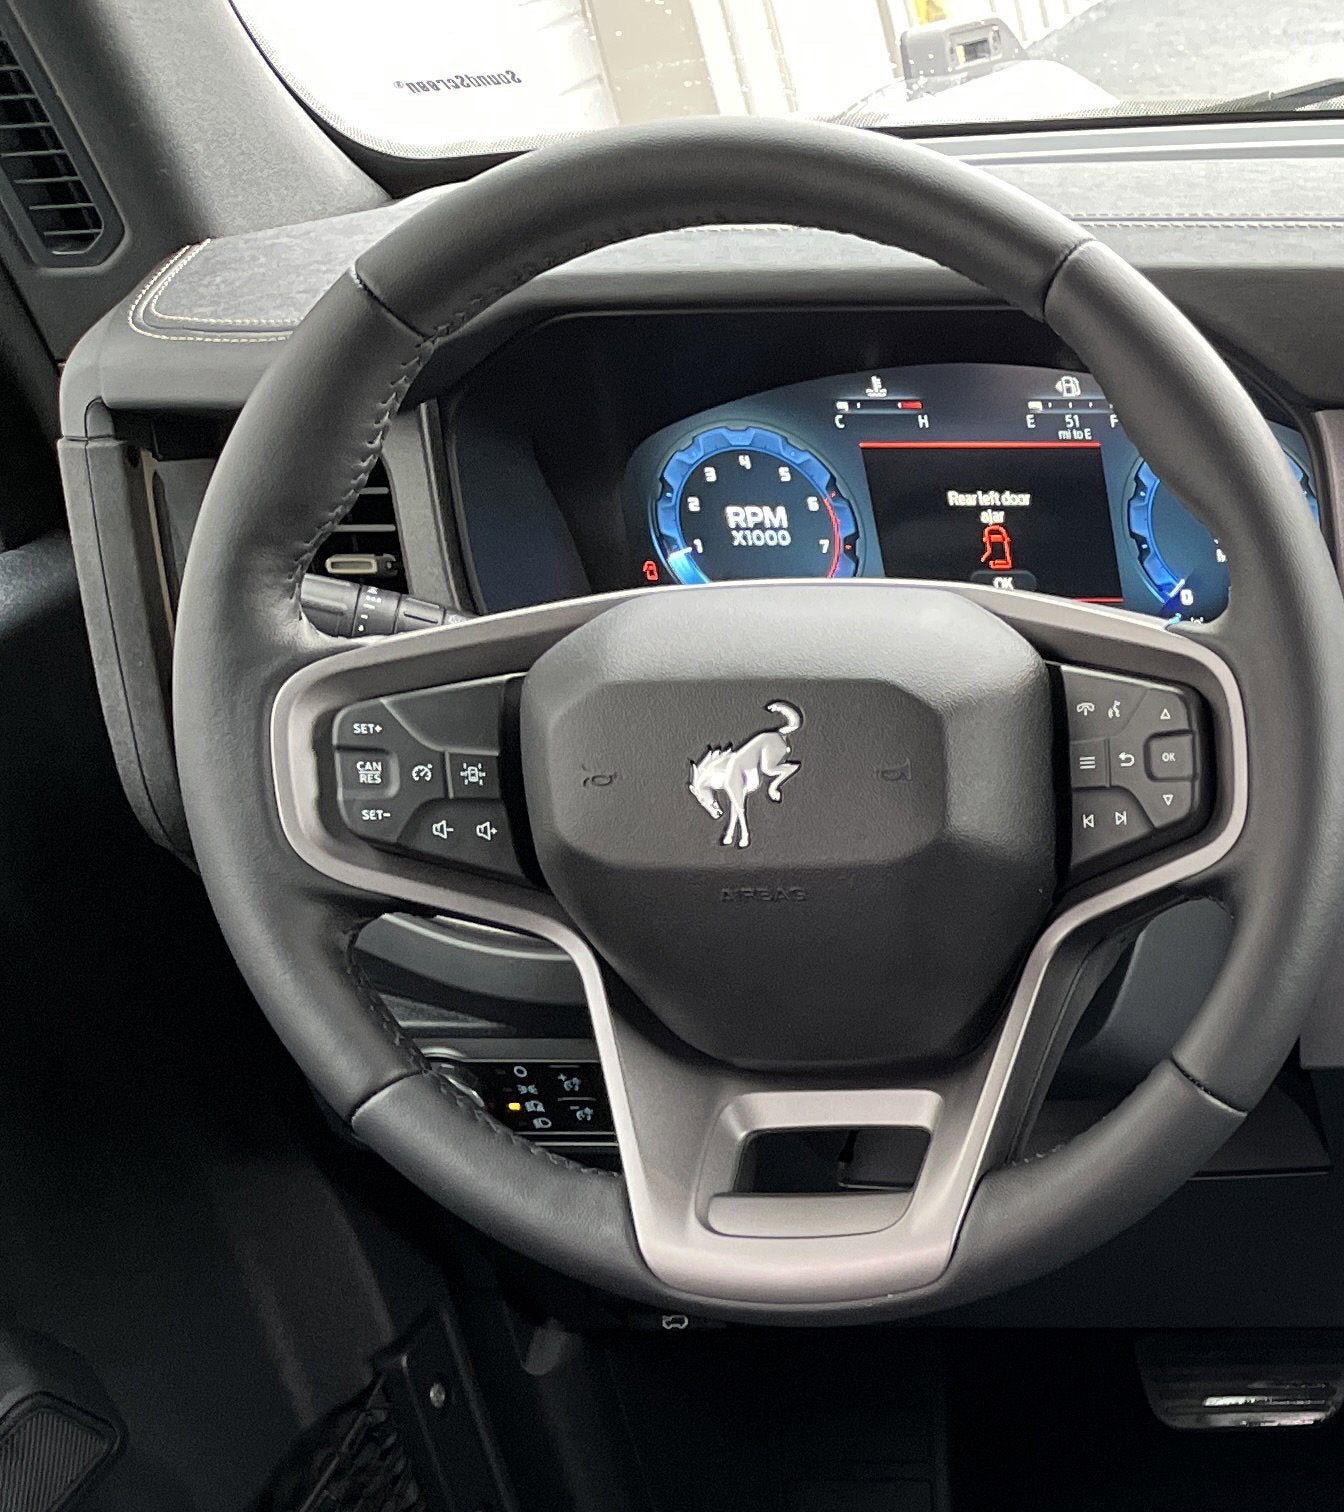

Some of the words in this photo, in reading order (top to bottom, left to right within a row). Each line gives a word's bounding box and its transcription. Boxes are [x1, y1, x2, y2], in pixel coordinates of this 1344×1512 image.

[834, 415, 846, 429] C
[918, 415, 929, 428] H
[1026, 415, 1036, 428] E
[1065, 414, 1080, 428] 51
[1072, 430, 1084, 440] to
[1084, 429, 1092, 440] E
[738, 454, 752, 470] 4
[703, 466, 717, 482] 3
[778, 466, 792, 482] 5
[686, 496, 701, 512] 2
[807, 497, 820, 512] 6
[947, 491, 977, 506] Rear
[977, 491, 1000, 506] left
[1001, 491, 1031, 506] door
[725, 505, 789, 529] RPM
[980, 509, 1006, 525] ajar
[692, 538, 704, 554] 1
[818, 539, 830, 554] 7
[1180, 588, 1194, 606] 0
[353, 723, 382, 735] SET+
[1161, 752, 1176, 762] OK
[356, 760, 382, 772] CAN
[359, 773, 382, 784] RES
